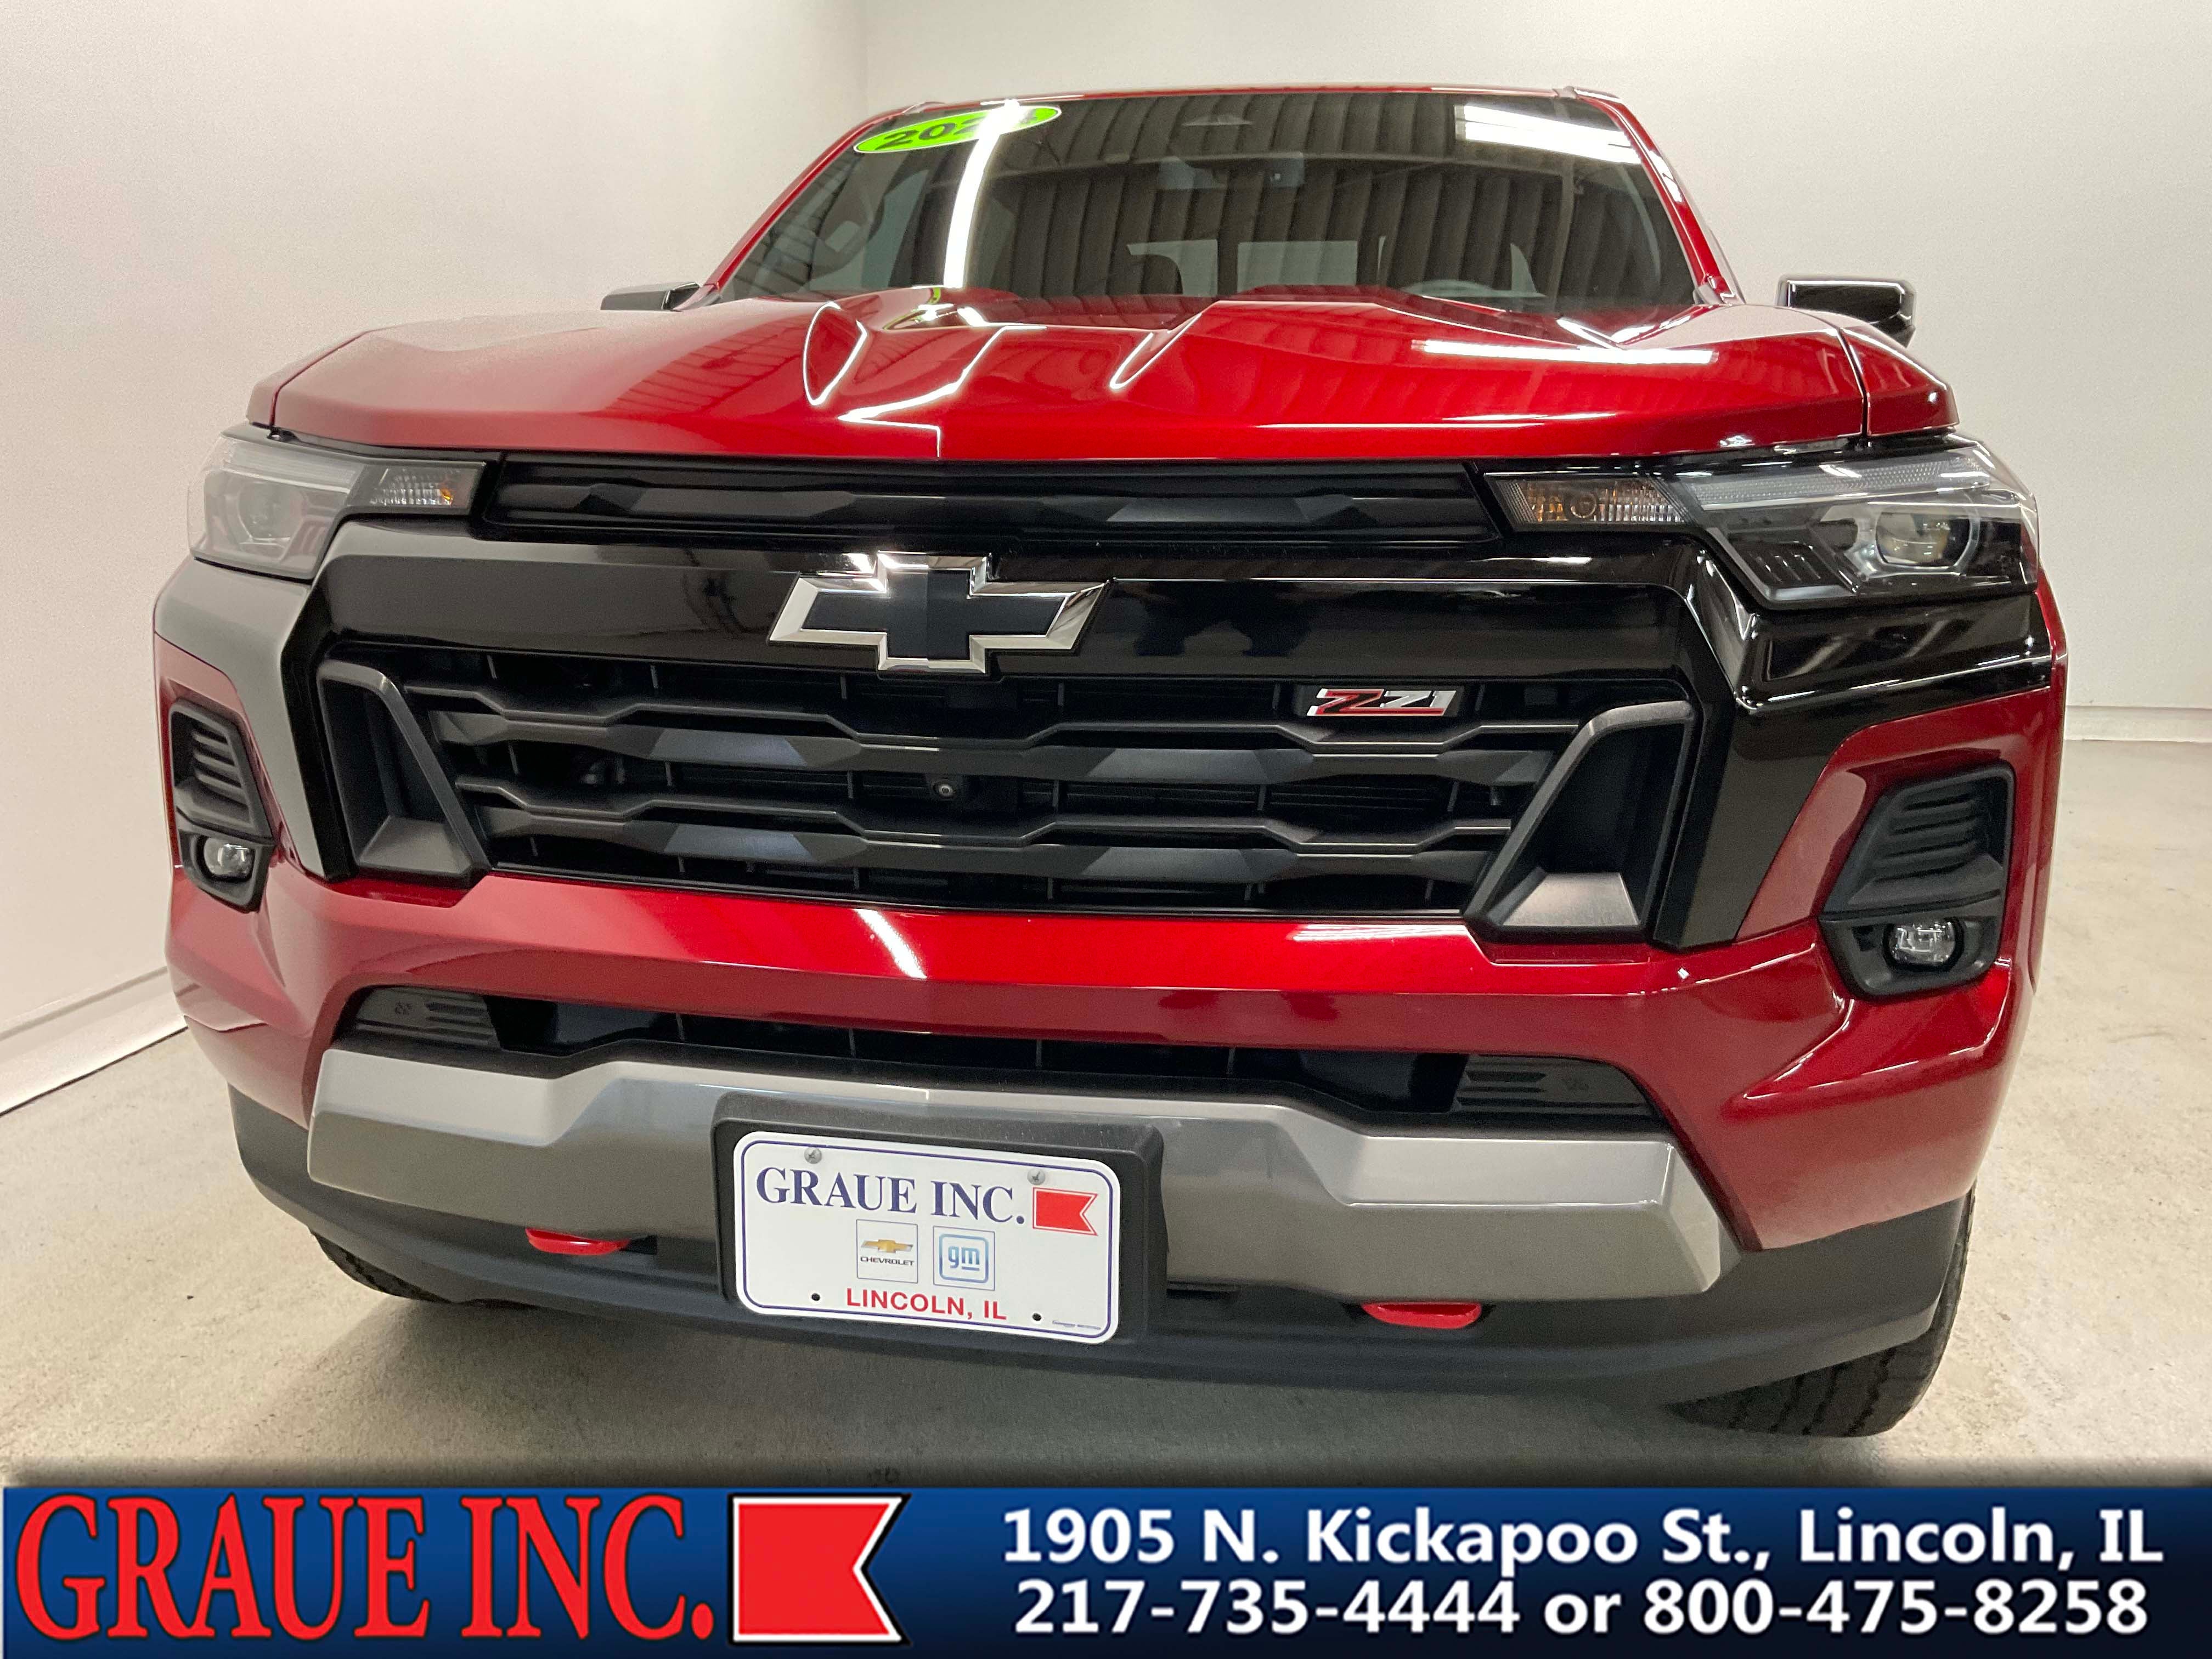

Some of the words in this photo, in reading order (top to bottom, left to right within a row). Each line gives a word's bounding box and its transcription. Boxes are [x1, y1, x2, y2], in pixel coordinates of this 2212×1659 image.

[1307, 688, 1457, 716] Z71
[756, 1167, 917, 1215] GRAUE
[930, 1181, 1025, 1224] INC.
[860, 1256, 915, 1266] CHEVROLET
[948, 1246, 980, 1271] gm
[846, 1288, 973, 1320] LINCOLN,
[983, 1300, 1007, 1321] IL
